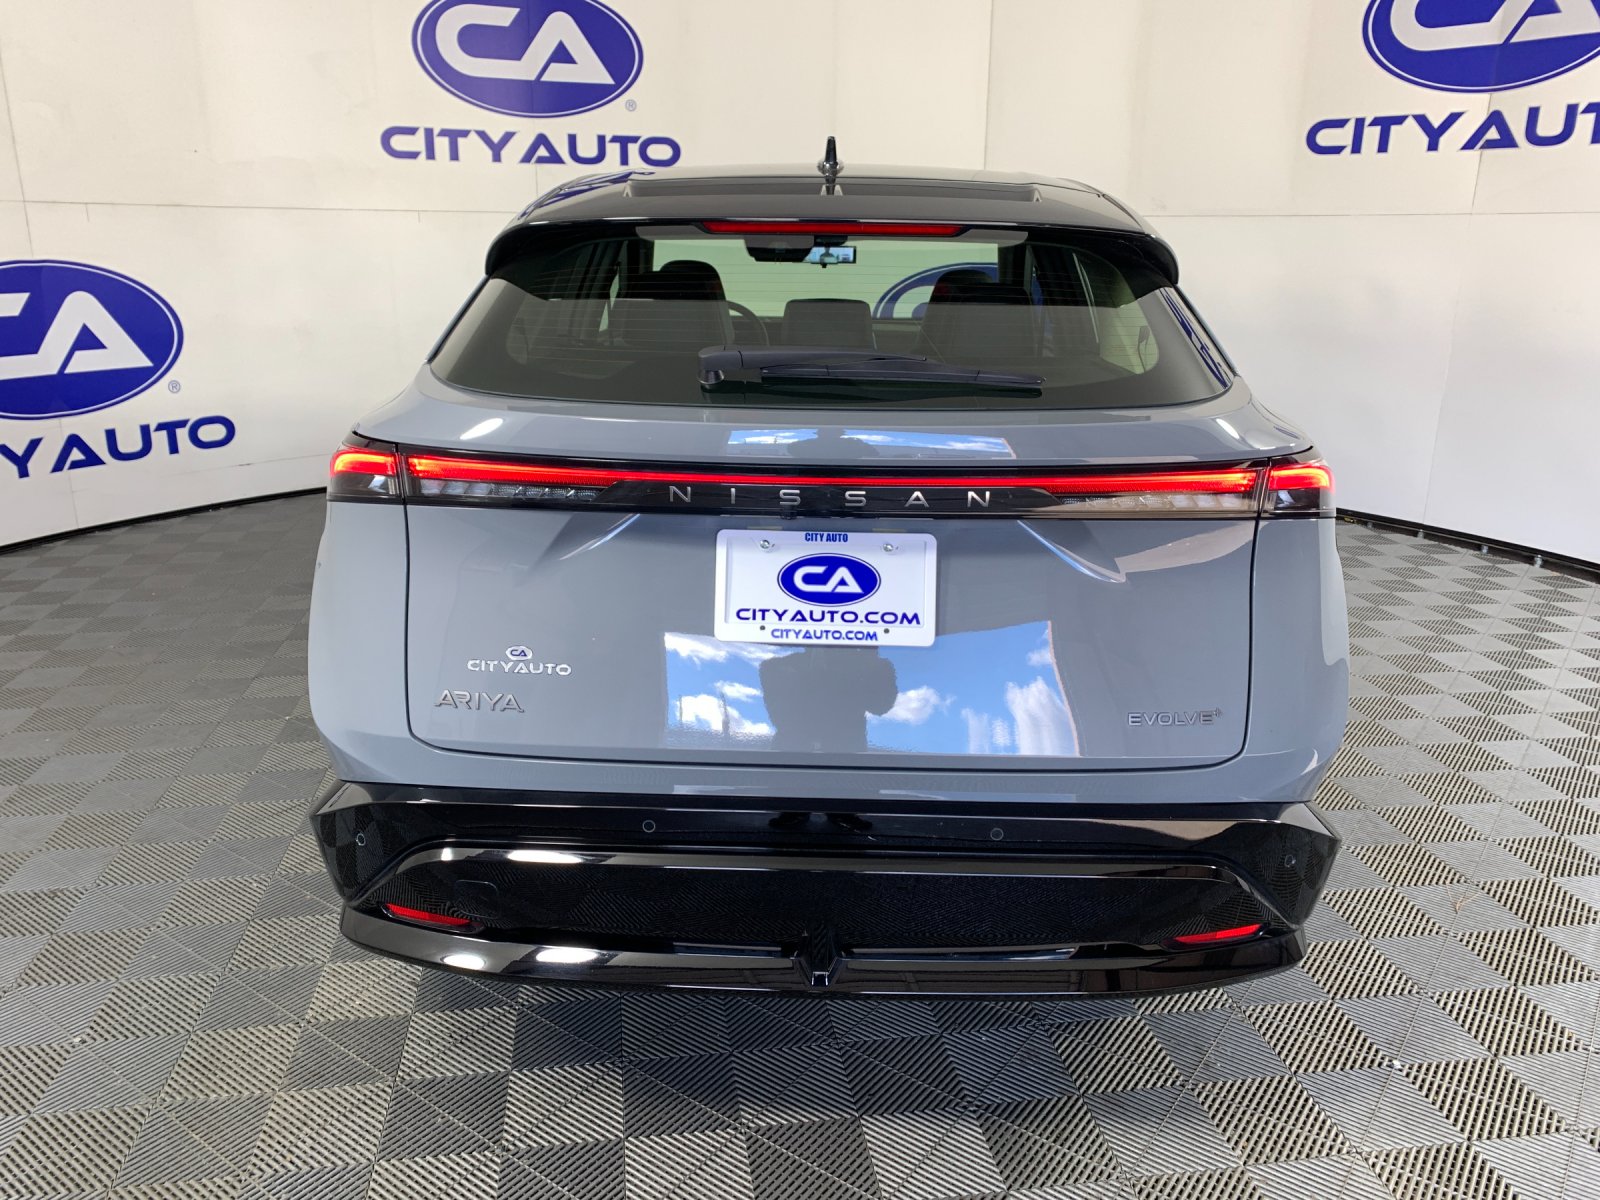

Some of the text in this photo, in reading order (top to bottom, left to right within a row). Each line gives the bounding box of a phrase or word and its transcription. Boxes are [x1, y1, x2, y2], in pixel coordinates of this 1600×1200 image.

[436, 3, 616, 85] CA
[668, 485, 991, 509] NISSAN
[804, 532, 849, 543] CITY AUTO
[793, 565, 865, 594] CA
[736, 608, 921, 625] CITYAUTO.COM
[771, 628, 879, 642] CITYAUTO.COM
[434, 689, 525, 713] ARIYA
